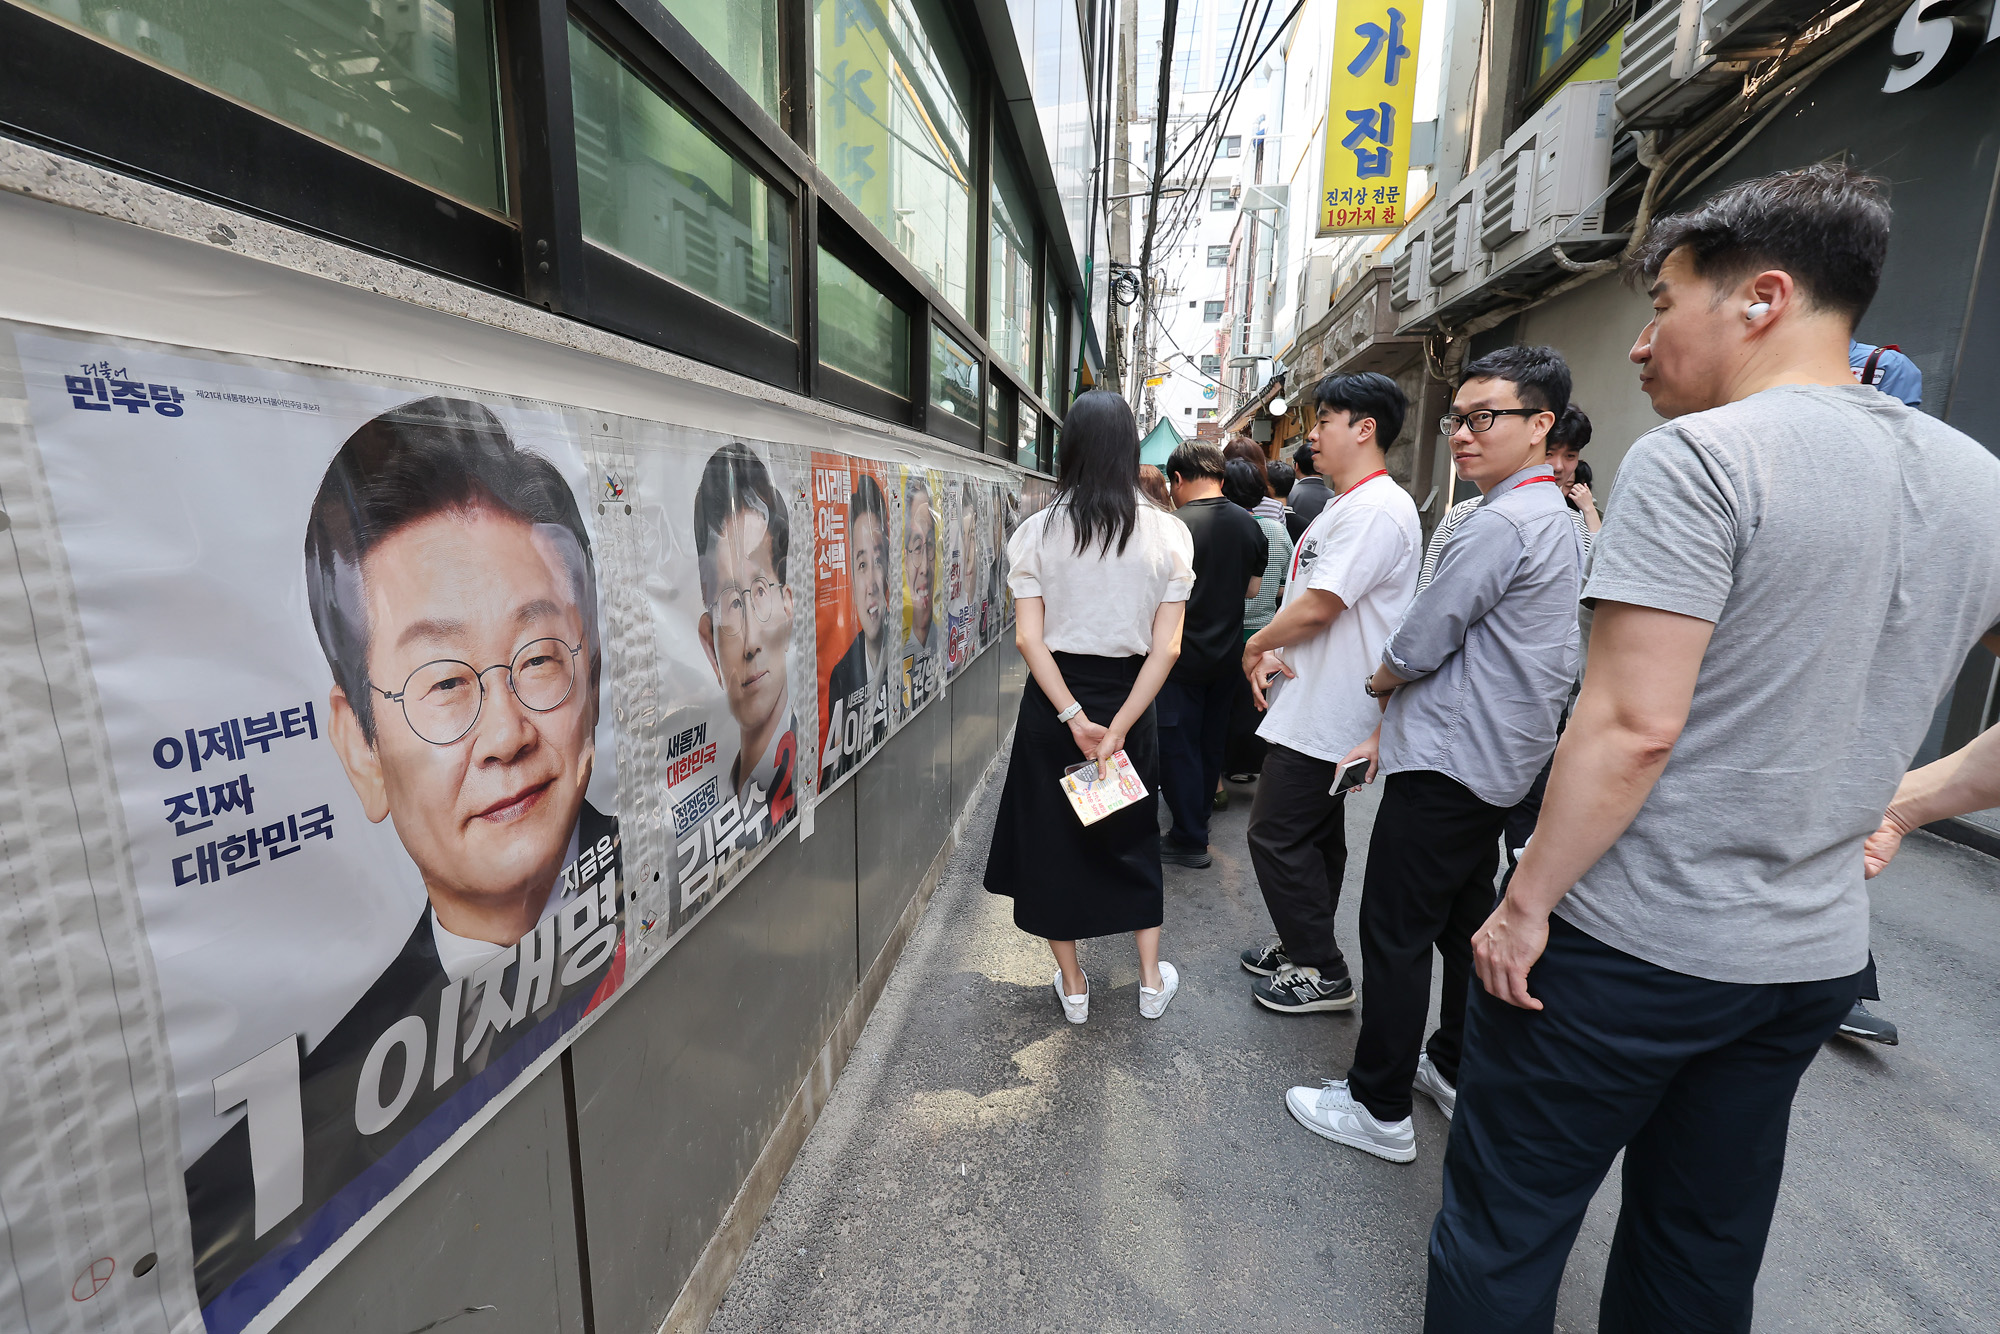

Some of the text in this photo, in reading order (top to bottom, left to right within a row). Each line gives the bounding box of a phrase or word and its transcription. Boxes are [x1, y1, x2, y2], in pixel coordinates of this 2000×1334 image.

[1881, 0, 2000, 93] S
[1325, 186, 1400, 206] 진지상 전문
[1326, 205, 1396, 227] 19가지 찬
[80, 360, 129, 381] 더불어
[64, 374, 186, 418] 민주당
[195, 389, 320, 412] 제21대 대통령선거 더불어민주당 후보자
[815, 468, 852, 505] 미래를
[818, 506, 845, 541] 여는
[818, 542, 847, 580] 선택
[948, 625, 958, 664] 6
[902, 655, 914, 708] 5
[153, 701, 319, 773] 이제부터
[666, 722, 707, 761] 새롭게
[821, 698, 843, 770] 4
[666, 742, 717, 789] 대한민국
[163, 773, 255, 837] 진짜
[674, 780, 718, 832] 정정당당
[677, 730, 796, 913] 김문수 2
[171, 803, 335, 887] 대한민국
[560, 835, 615, 899] 지금은
[1291, 983, 1320, 1003] N
[212, 866, 617, 1240] 1 이재명
